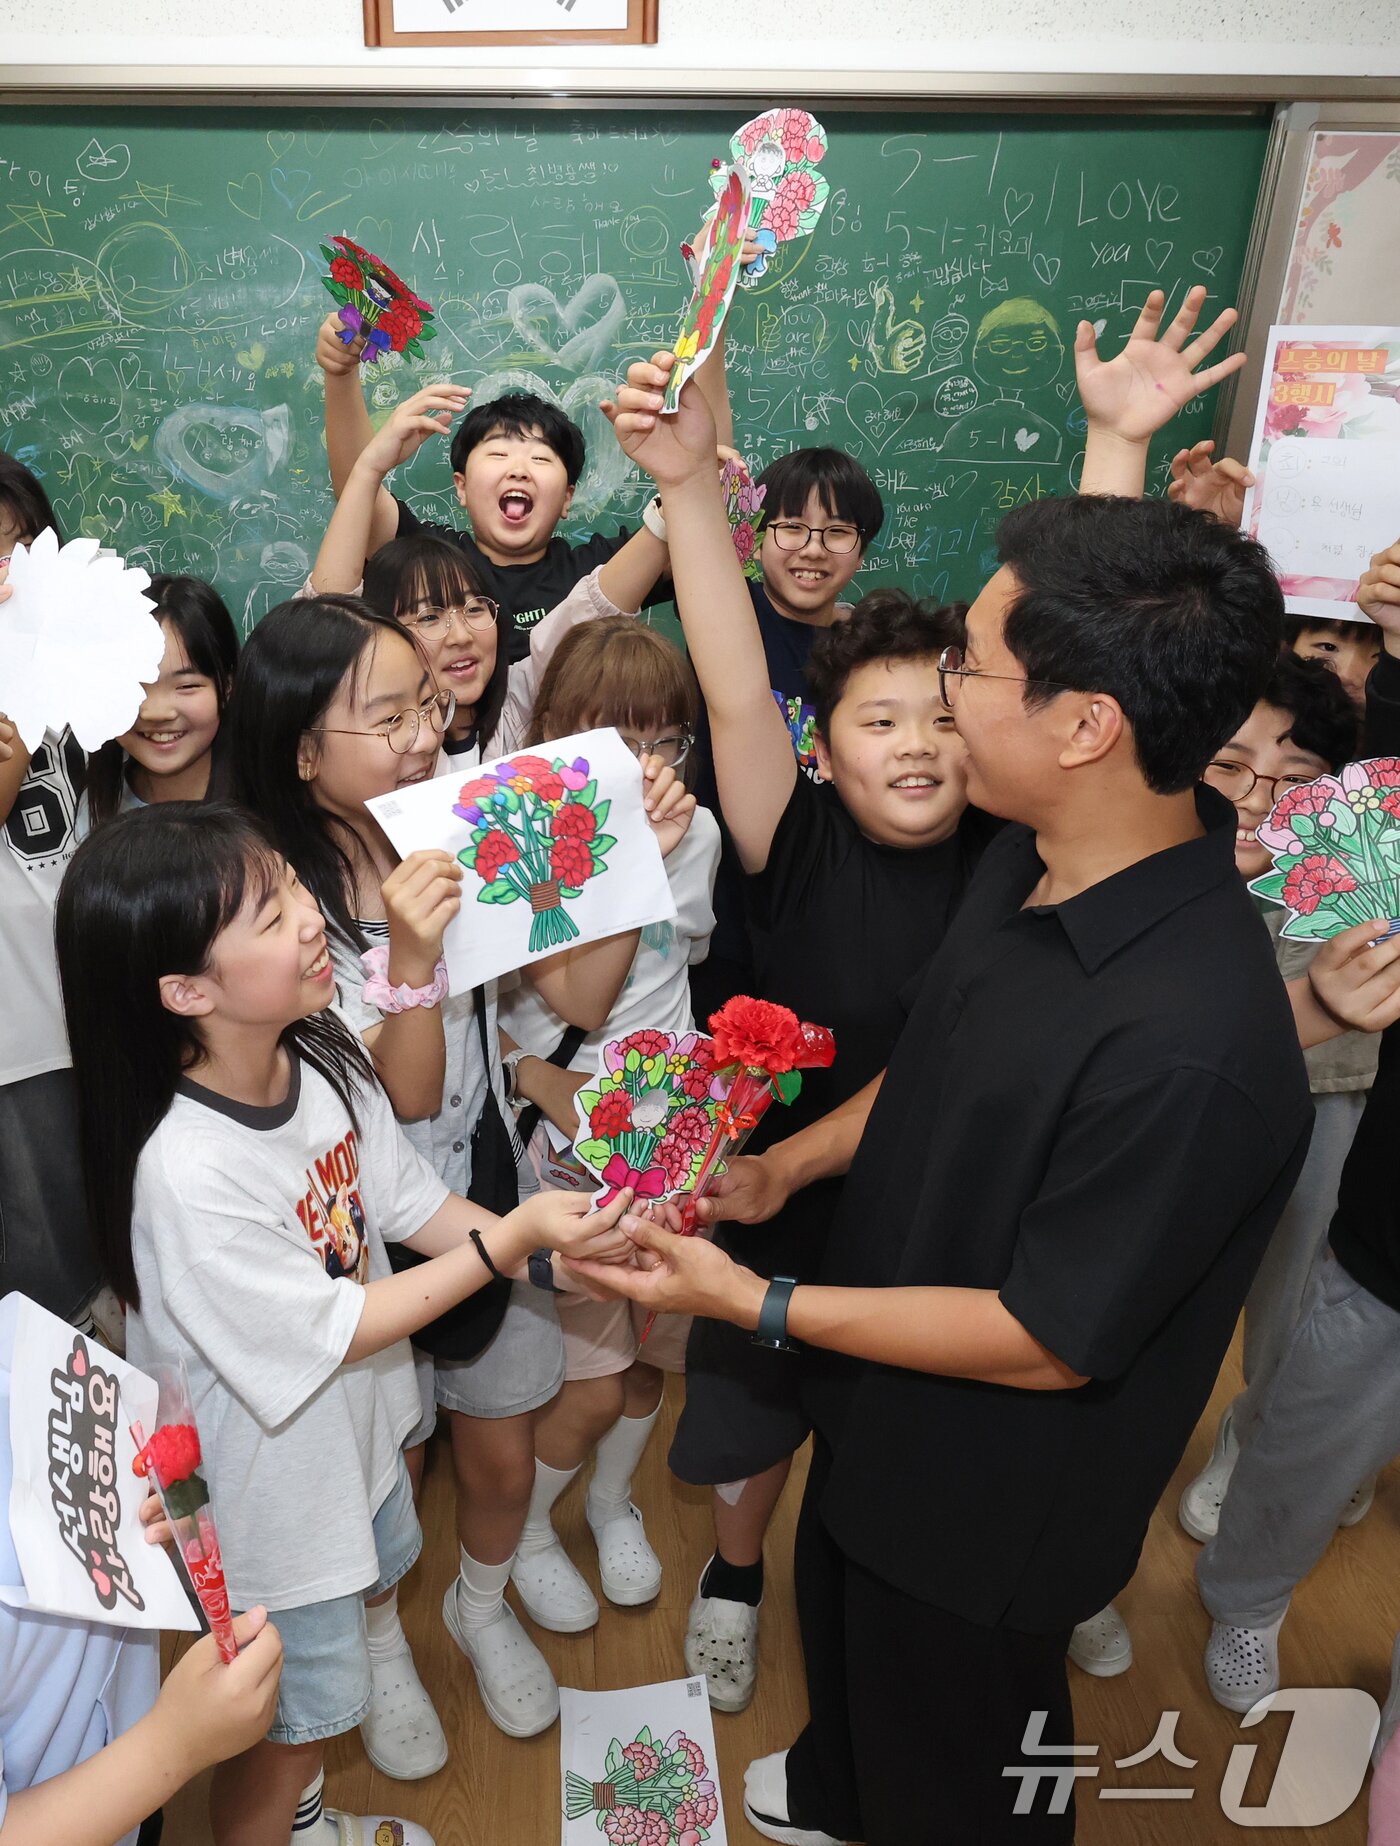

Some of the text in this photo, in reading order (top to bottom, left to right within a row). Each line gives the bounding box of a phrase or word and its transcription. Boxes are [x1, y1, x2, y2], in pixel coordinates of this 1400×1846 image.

[880, 132, 1003, 197] 5-1
[785, 331, 811, 344] are
[1278, 350, 1380, 371] 스승의 날
[1274, 383, 1334, 405] 3행시
[968, 427, 1007, 452] 5-1
[1328, 496, 1363, 521] 선생님
[50, 1368, 89, 1562] 선생님
[87, 1370, 142, 1608] 사랑해요
